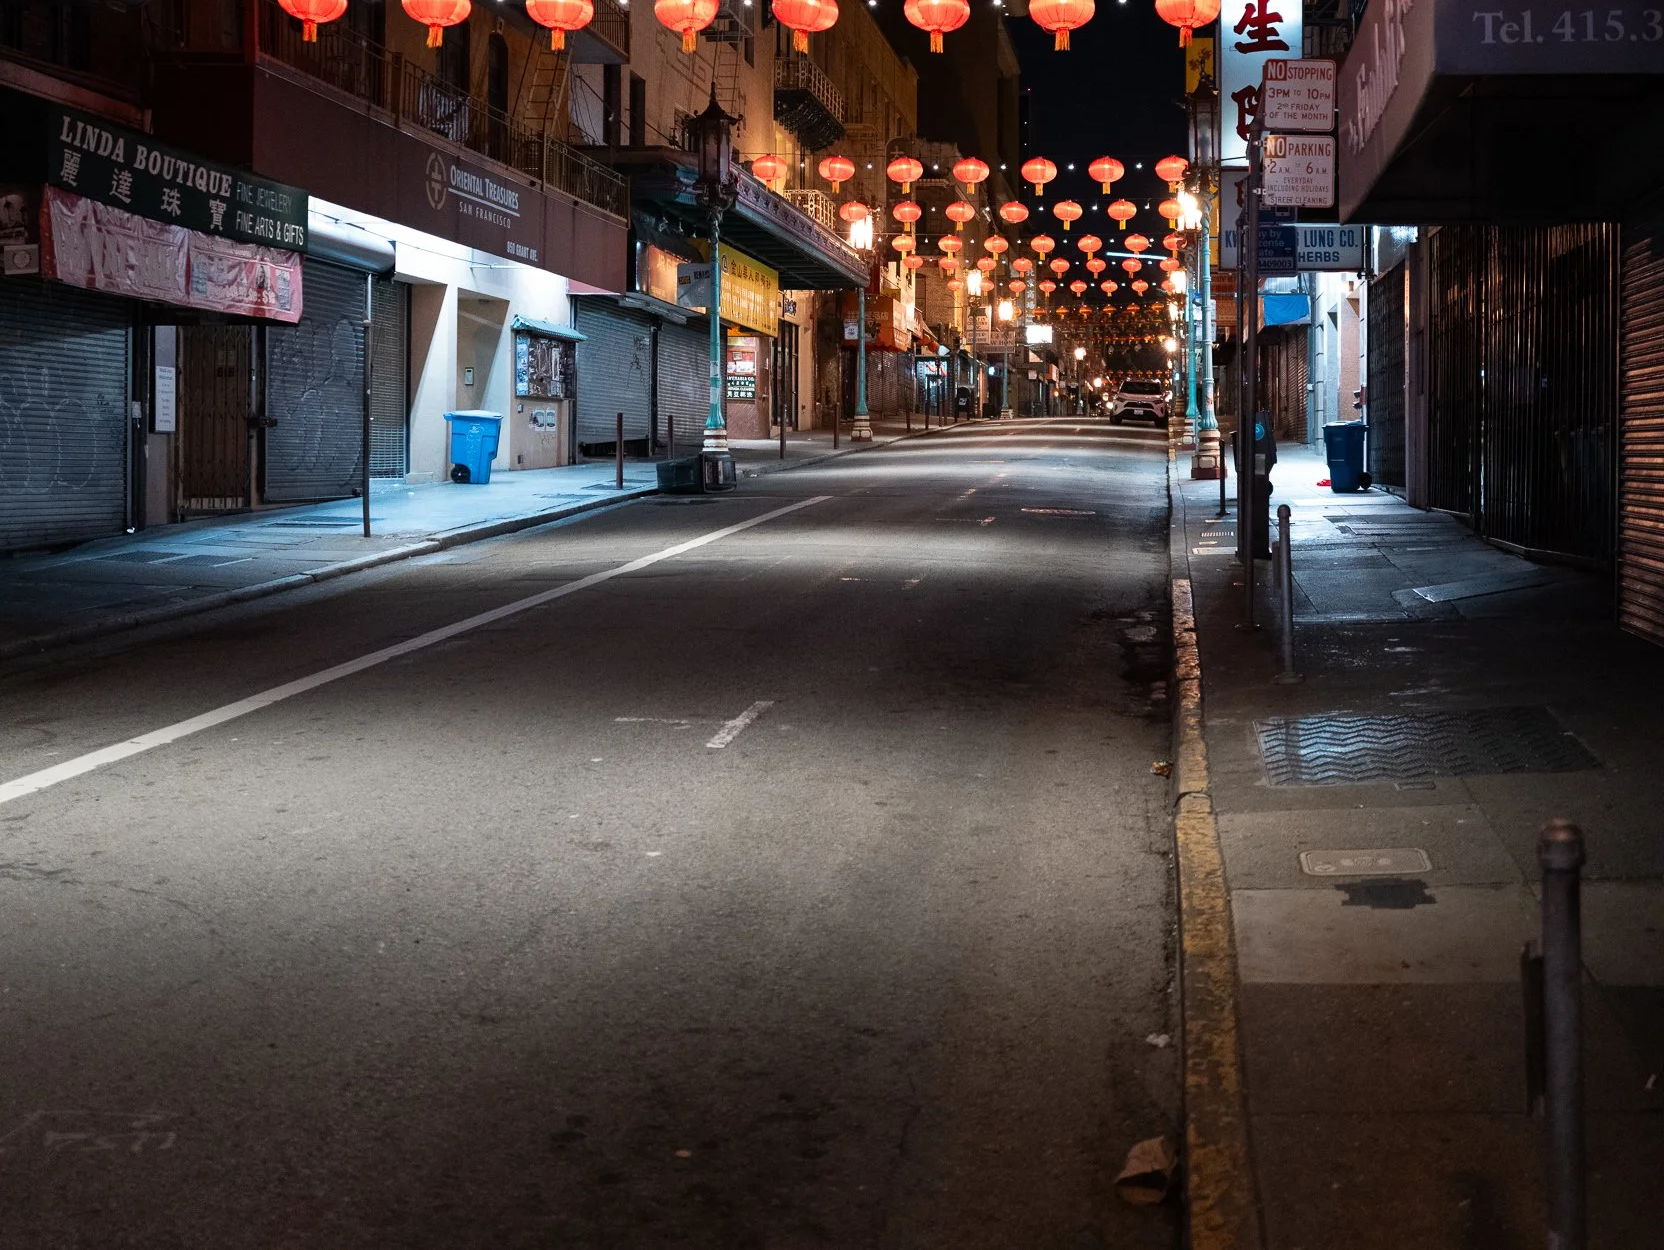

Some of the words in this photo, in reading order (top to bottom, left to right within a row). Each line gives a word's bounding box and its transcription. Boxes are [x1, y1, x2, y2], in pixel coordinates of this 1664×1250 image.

[1472, 9, 1544, 44] Tel.
[1551, 9, 1664, 42] 415.3
[1267, 61, 1285, 80] NO
[1287, 66, 1332, 81] STOPPING
[1268, 87, 1290, 98] 3PM
[1307, 89, 1330, 100] 10PM
[1290, 103, 1320, 112] FRIDAY
[59, 115, 125, 164] LINDA
[133, 144, 232, 198] BOUTIQUE
[1267, 137, 1285, 157] NO
[1288, 143, 1331, 157] PARKING
[1306, 161, 1313, 174] 6
[236, 181, 253, 204] FINE
[450, 165, 484, 196] ORIENTAL
[485, 178, 519, 210] TREASURES
[1301, 185, 1329, 193] HOLIDAYS
[1270, 196, 1293, 204] STREET
[459, 202, 473, 215] SAN
[475, 207, 511, 229] FRANCISCO
[235, 210, 253, 234] FINE
[254, 216, 274, 238] ARTS
[276, 221, 281, 240] &
[283, 223, 304, 246] GIFTS
[1270, 229, 1282, 239] by
[1304, 230, 1334, 248] LUNG
[1339, 230, 1358, 248] CO.
[1299, 251, 1340, 262] HERBS
